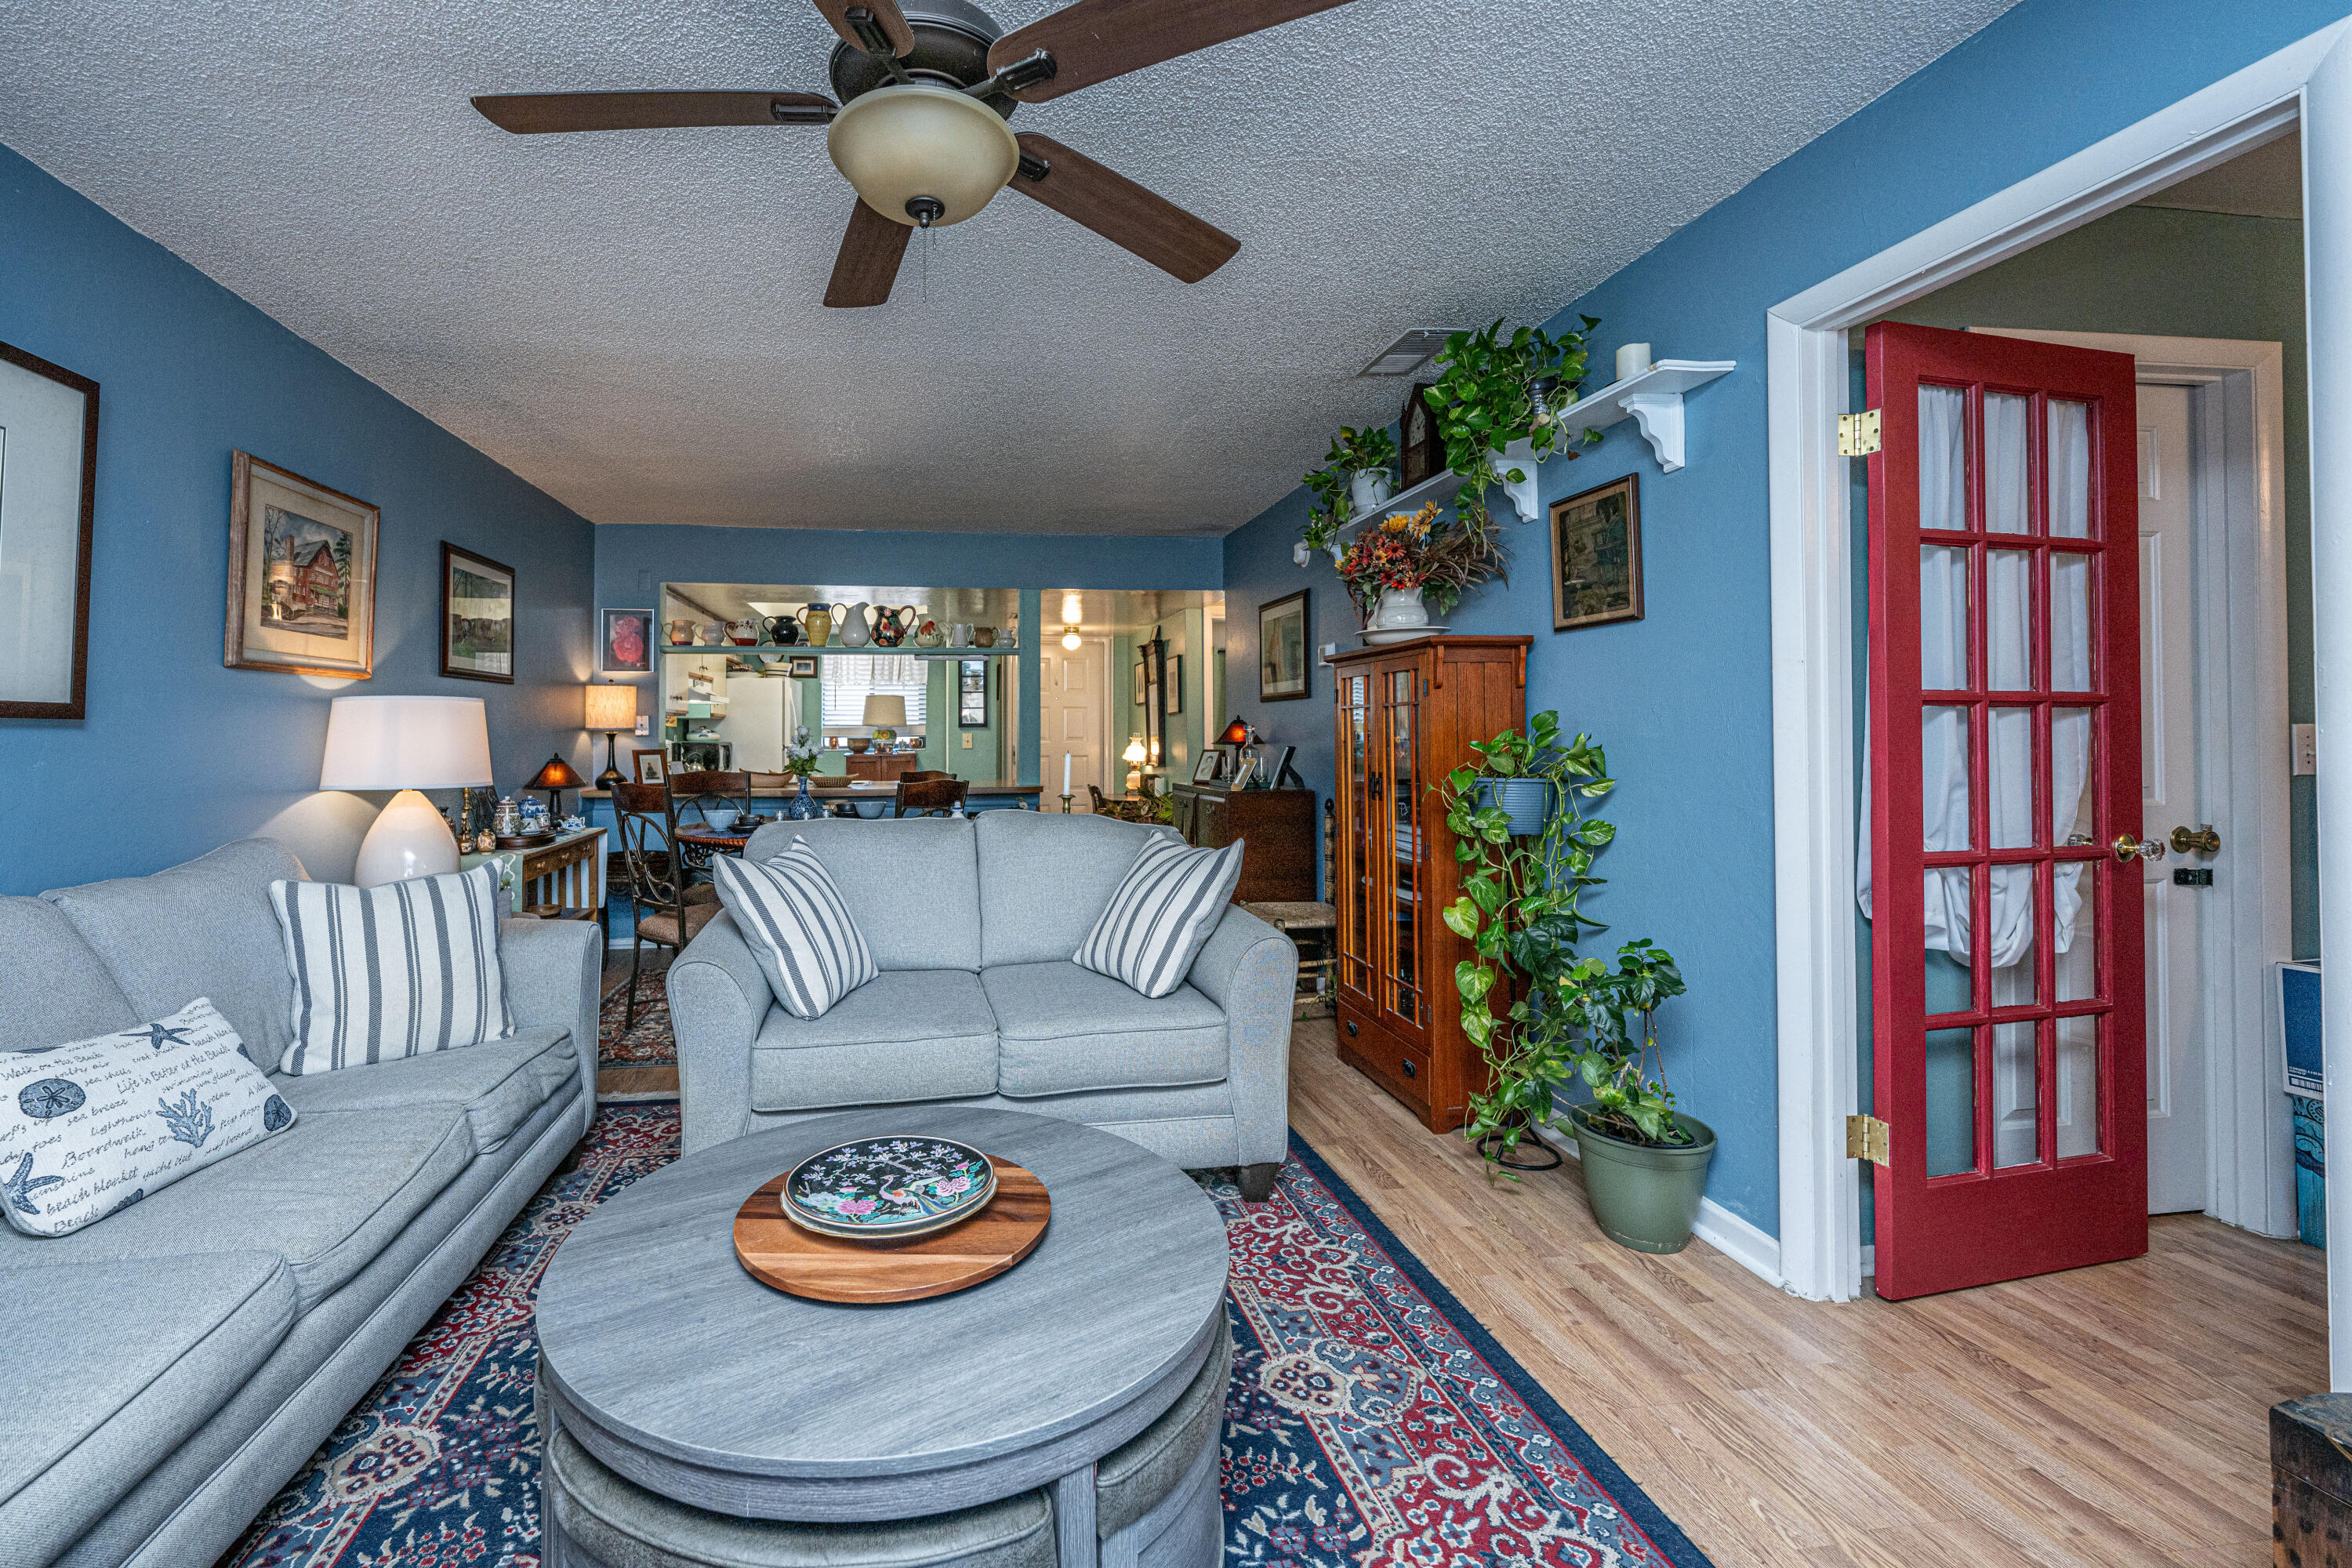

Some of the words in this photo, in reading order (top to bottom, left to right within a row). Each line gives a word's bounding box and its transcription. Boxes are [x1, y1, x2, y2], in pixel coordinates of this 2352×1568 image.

[73, 1052, 103, 1062] Beach
[118, 1079, 140, 1094] Life
[140, 1075, 151, 1085] is
[151, 1065, 179, 1081] Better
[181, 1059, 191, 1070] at
[191, 1054, 206, 1065] the
[205, 1044, 230, 1060] Beach
[85, 1077, 102, 1087] sea
[104, 1069, 132, 1081] shells
[67, 1113, 88, 1127] sea
[91, 1100, 128, 1116] breeze
[92, 1109, 153, 1136] lighthouse
[32, 1134, 62, 1152] toes
[61, 1127, 147, 1170] Boardwalk
[124, 1141, 155, 1159] hang
[31, 1167, 95, 1201] sunshine
[47, 1187, 90, 1217] beach
[93, 1167, 138, 1195] blanket
[54, 1204, 100, 1232] Beach
